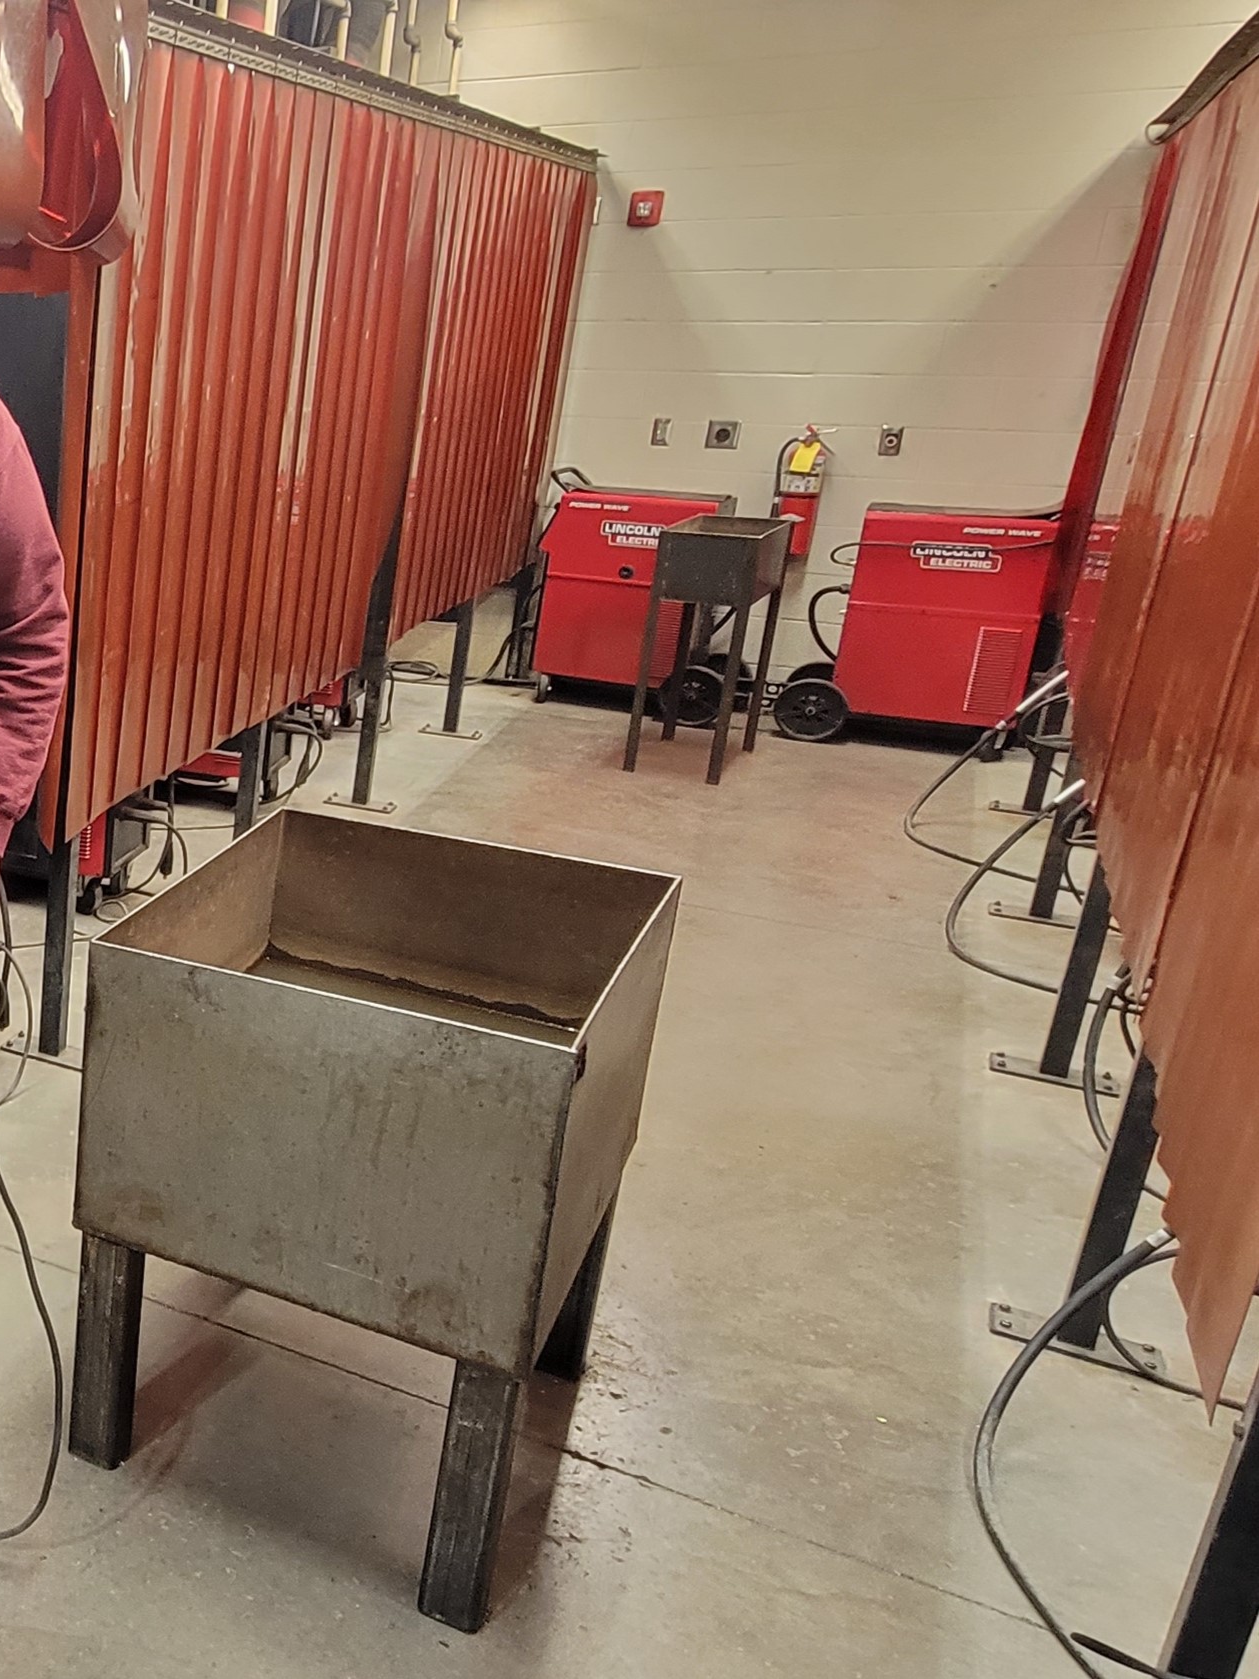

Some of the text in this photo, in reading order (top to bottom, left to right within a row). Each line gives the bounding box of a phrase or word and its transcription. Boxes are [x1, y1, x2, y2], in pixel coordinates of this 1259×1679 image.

[569, 501, 602, 509] POWER
[604, 523, 662, 537] LINCOLN
[962, 526, 1042, 537] POWER WAVE
[616, 535, 659, 547] ELECTRI
[929, 557, 992, 569] ELECTRIC
